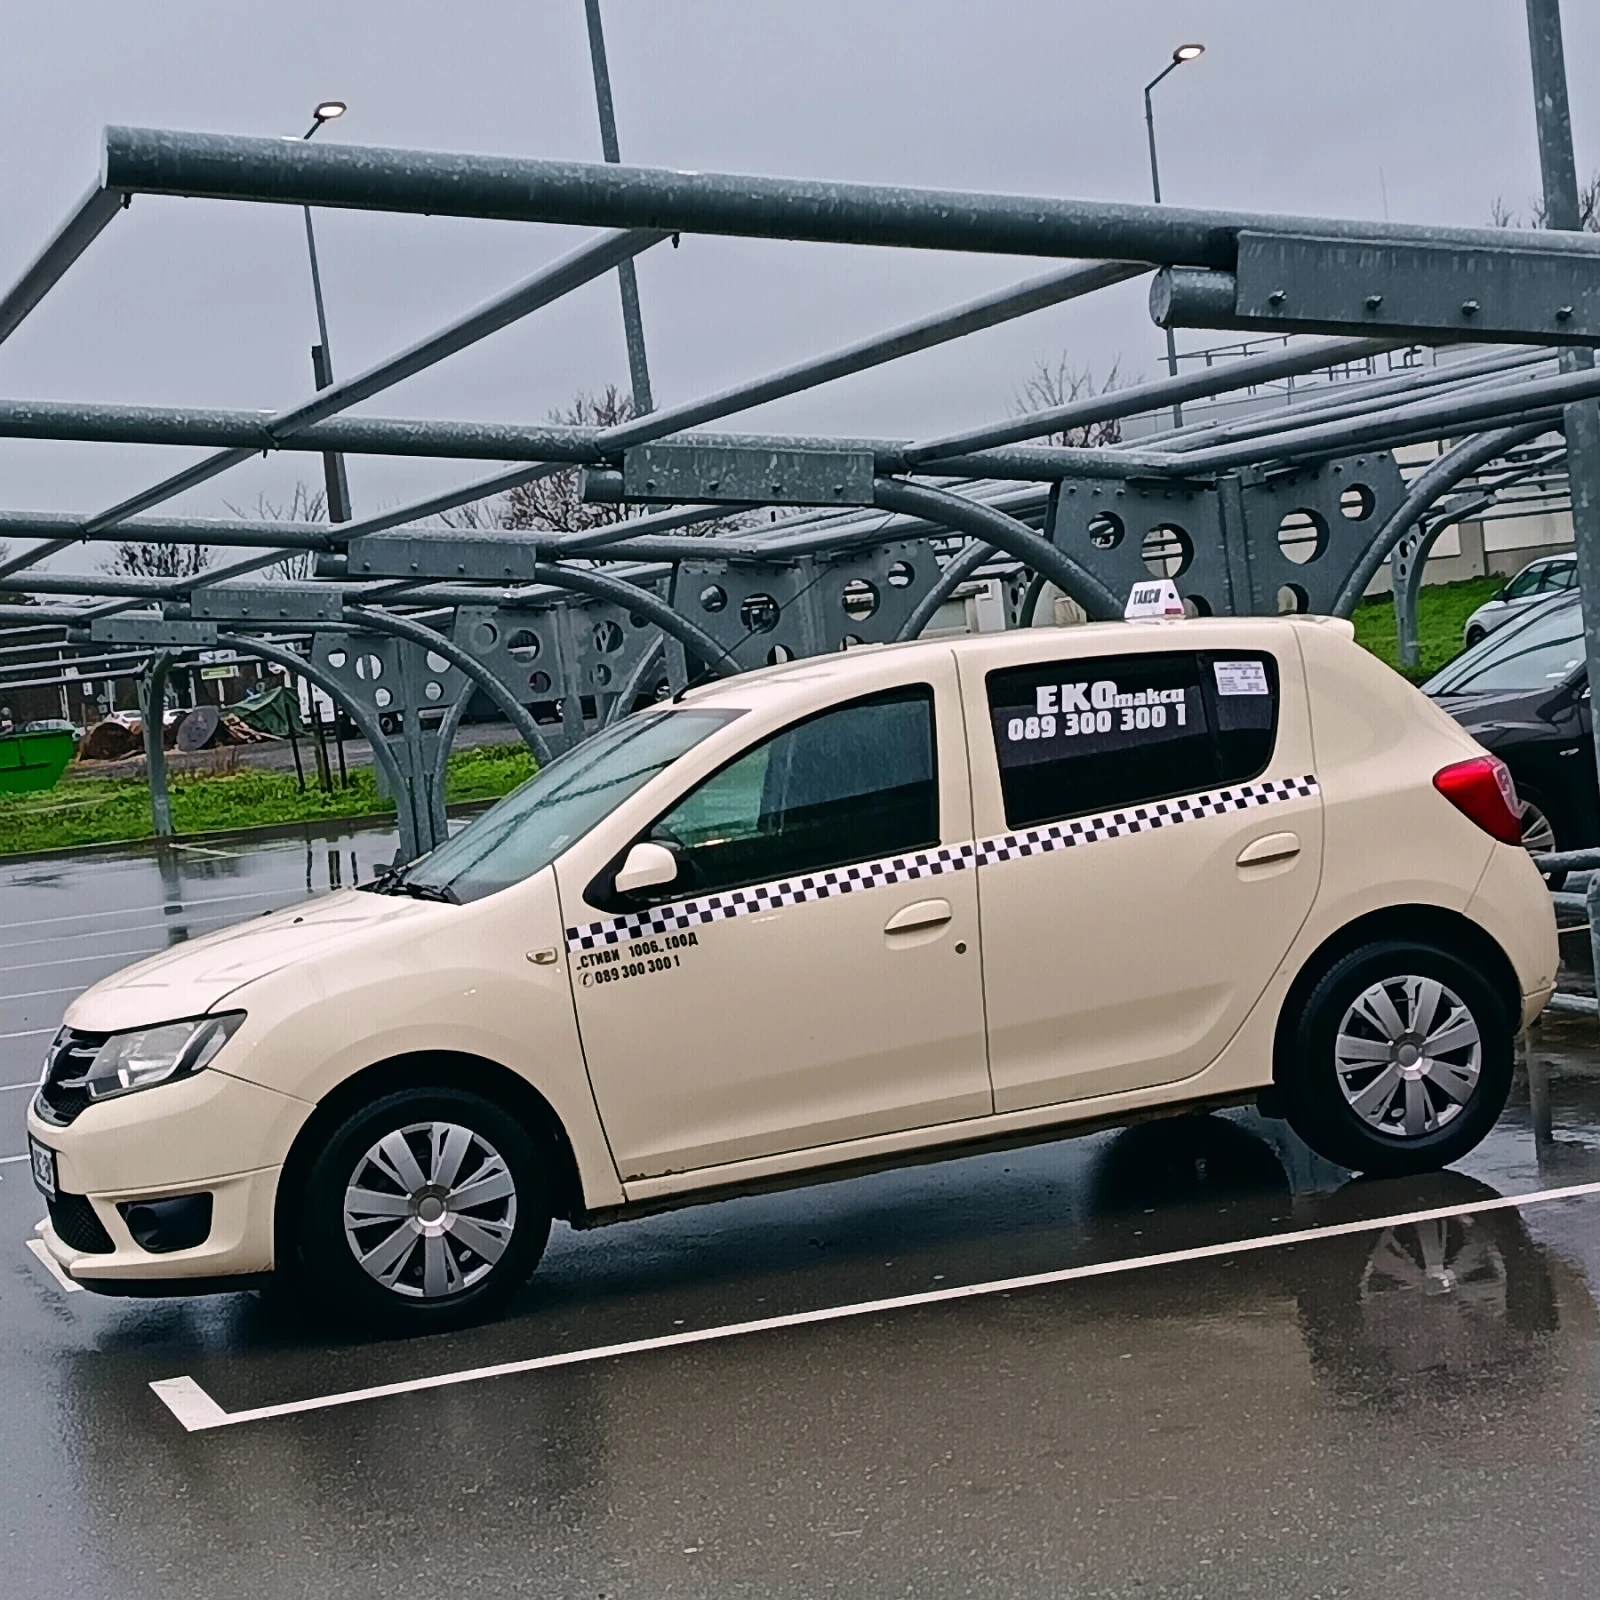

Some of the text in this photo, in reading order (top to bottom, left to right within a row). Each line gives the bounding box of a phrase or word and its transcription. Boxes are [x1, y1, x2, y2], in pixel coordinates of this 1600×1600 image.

[1008, 704, 1186, 741] 089 300 300 1
[595, 955, 680, 984] 089 300 300 1
